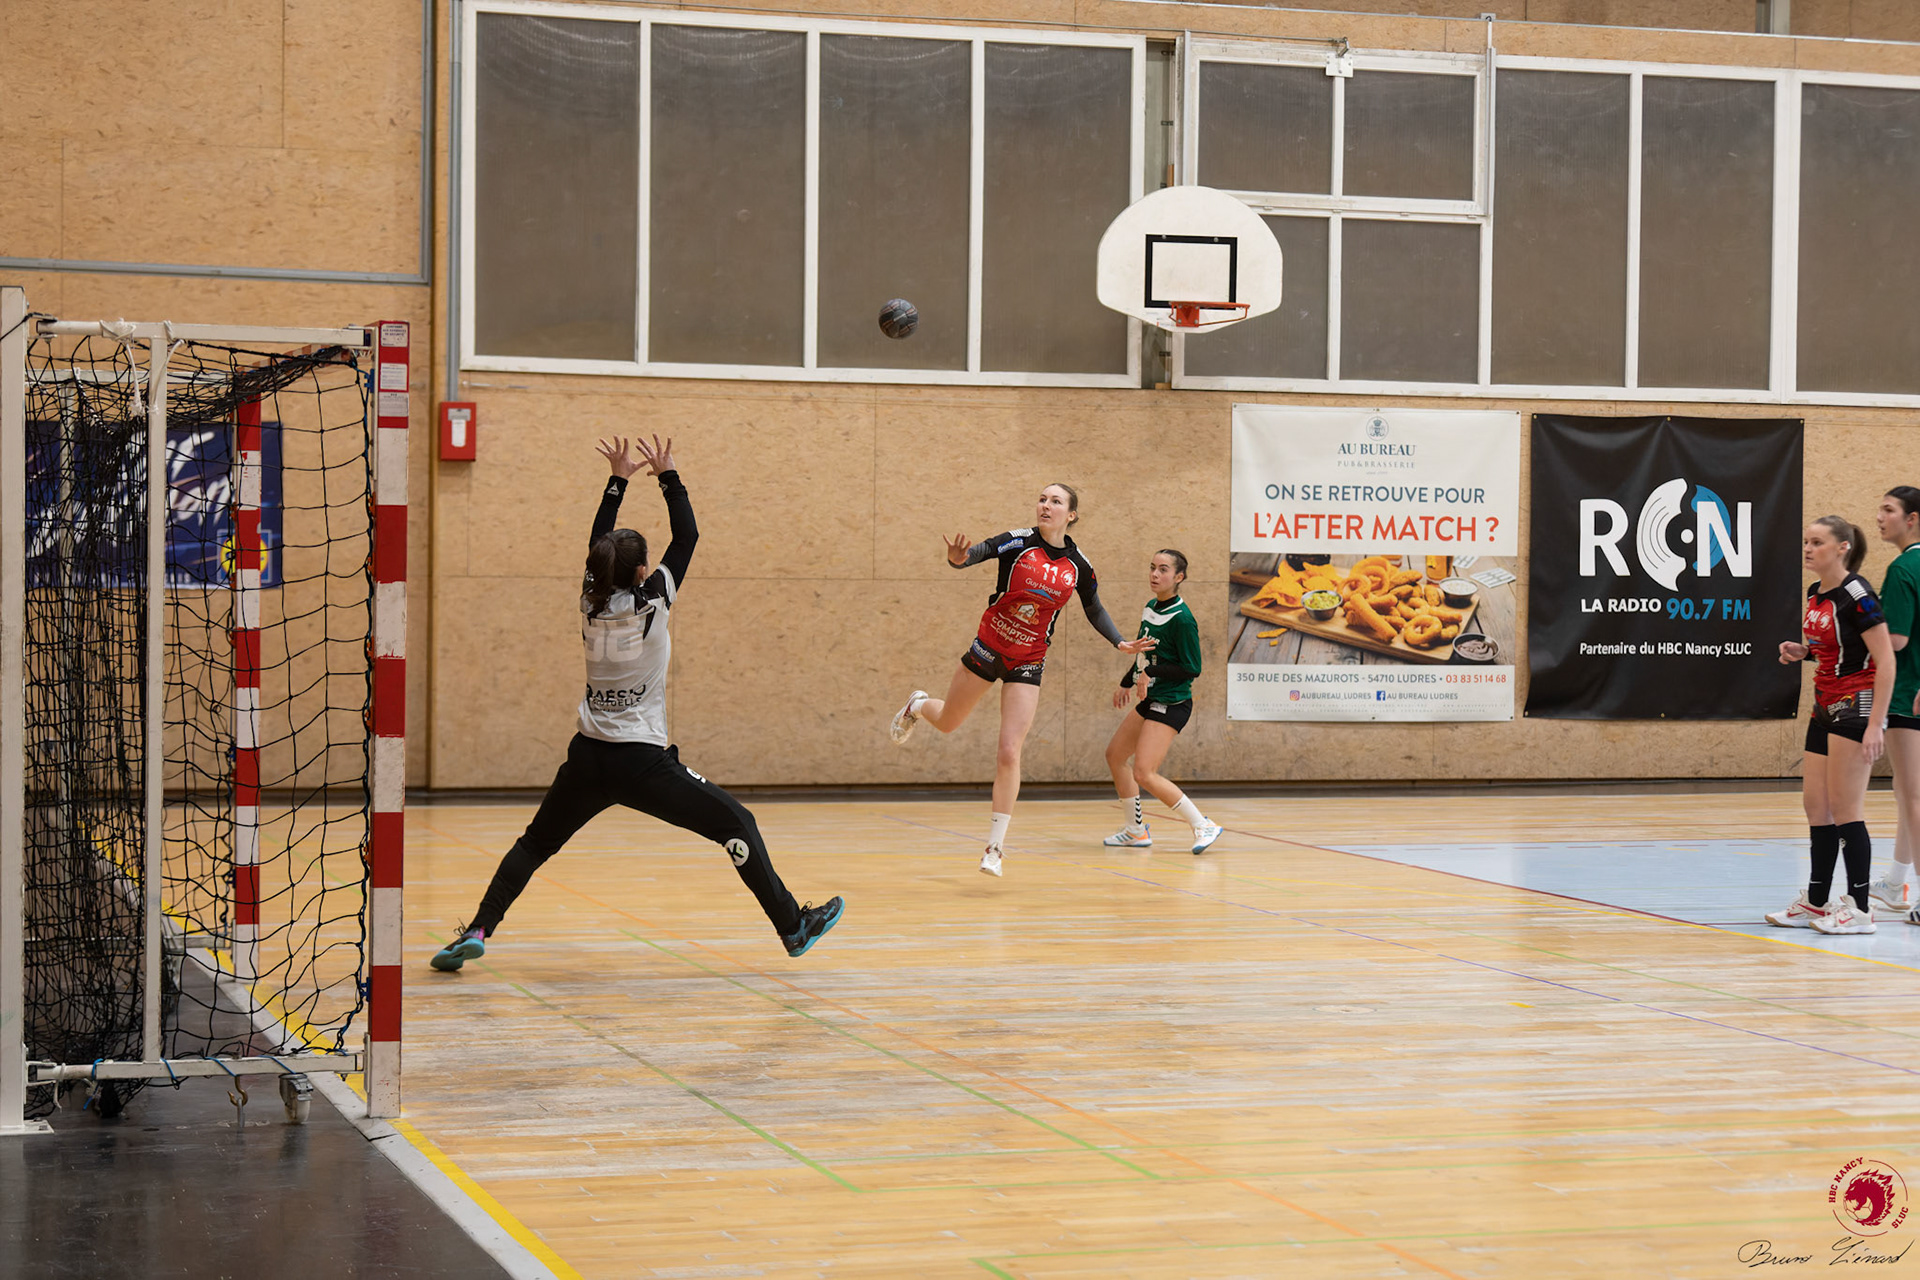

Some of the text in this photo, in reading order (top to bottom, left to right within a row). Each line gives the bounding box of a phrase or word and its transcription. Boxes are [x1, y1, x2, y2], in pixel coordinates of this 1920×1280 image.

[1338, 442, 1416, 457] AU BUREAU
[1265, 484, 1485, 504] ON SE RETROUVE POUR
[1253, 512, 1500, 542] L'AFTER MATCH ?
[1042, 563, 1058, 584] 11
[1025, 577, 1062, 597] Guy Hoquet
[1581, 597, 1751, 621] LA RADIO 90.7 FM
[1579, 641, 1752, 658] Partenaire du HBC Nancy SLUC
[1236, 672, 1255, 682] 350
[1258, 673, 1279, 682] RUE
[1282, 673, 1302, 683] DES
[1305, 673, 1360, 683] MAZUROTS
[1368, 674, 1395, 683] 54710
[1397, 674, 1437, 683] LUDRES
[1445, 674, 1458, 683] 03
[1460, 674, 1472, 683] 83
[1473, 674, 1482, 683] 51
[1484, 674, 1494, 683] 14
[1495, 674, 1507, 683] 68
[1387, 692, 1459, 700] AU BUREAU LUDRES
